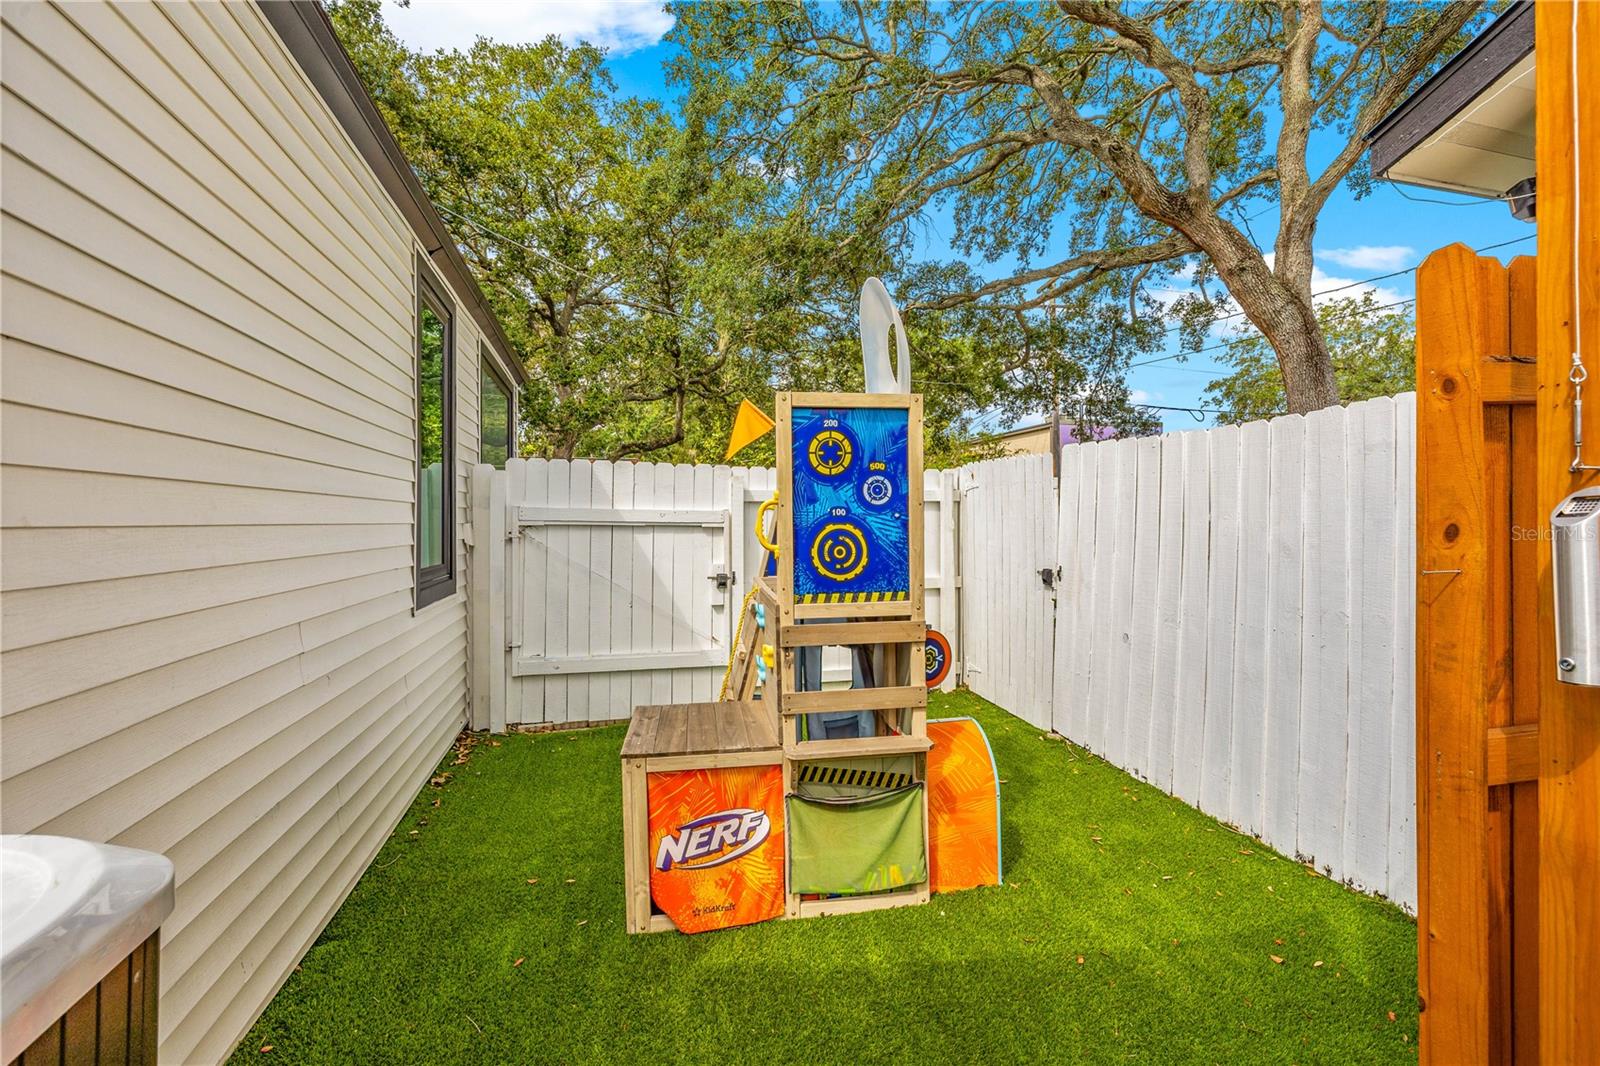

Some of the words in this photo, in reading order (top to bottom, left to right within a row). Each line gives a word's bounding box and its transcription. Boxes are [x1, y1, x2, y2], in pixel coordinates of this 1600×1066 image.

[823, 419, 839, 428] 200
[869, 462, 886, 471] 500
[831, 508, 847, 516] 100
[655, 809, 767, 872] NERF
[703, 903, 736, 915] KidKraft
